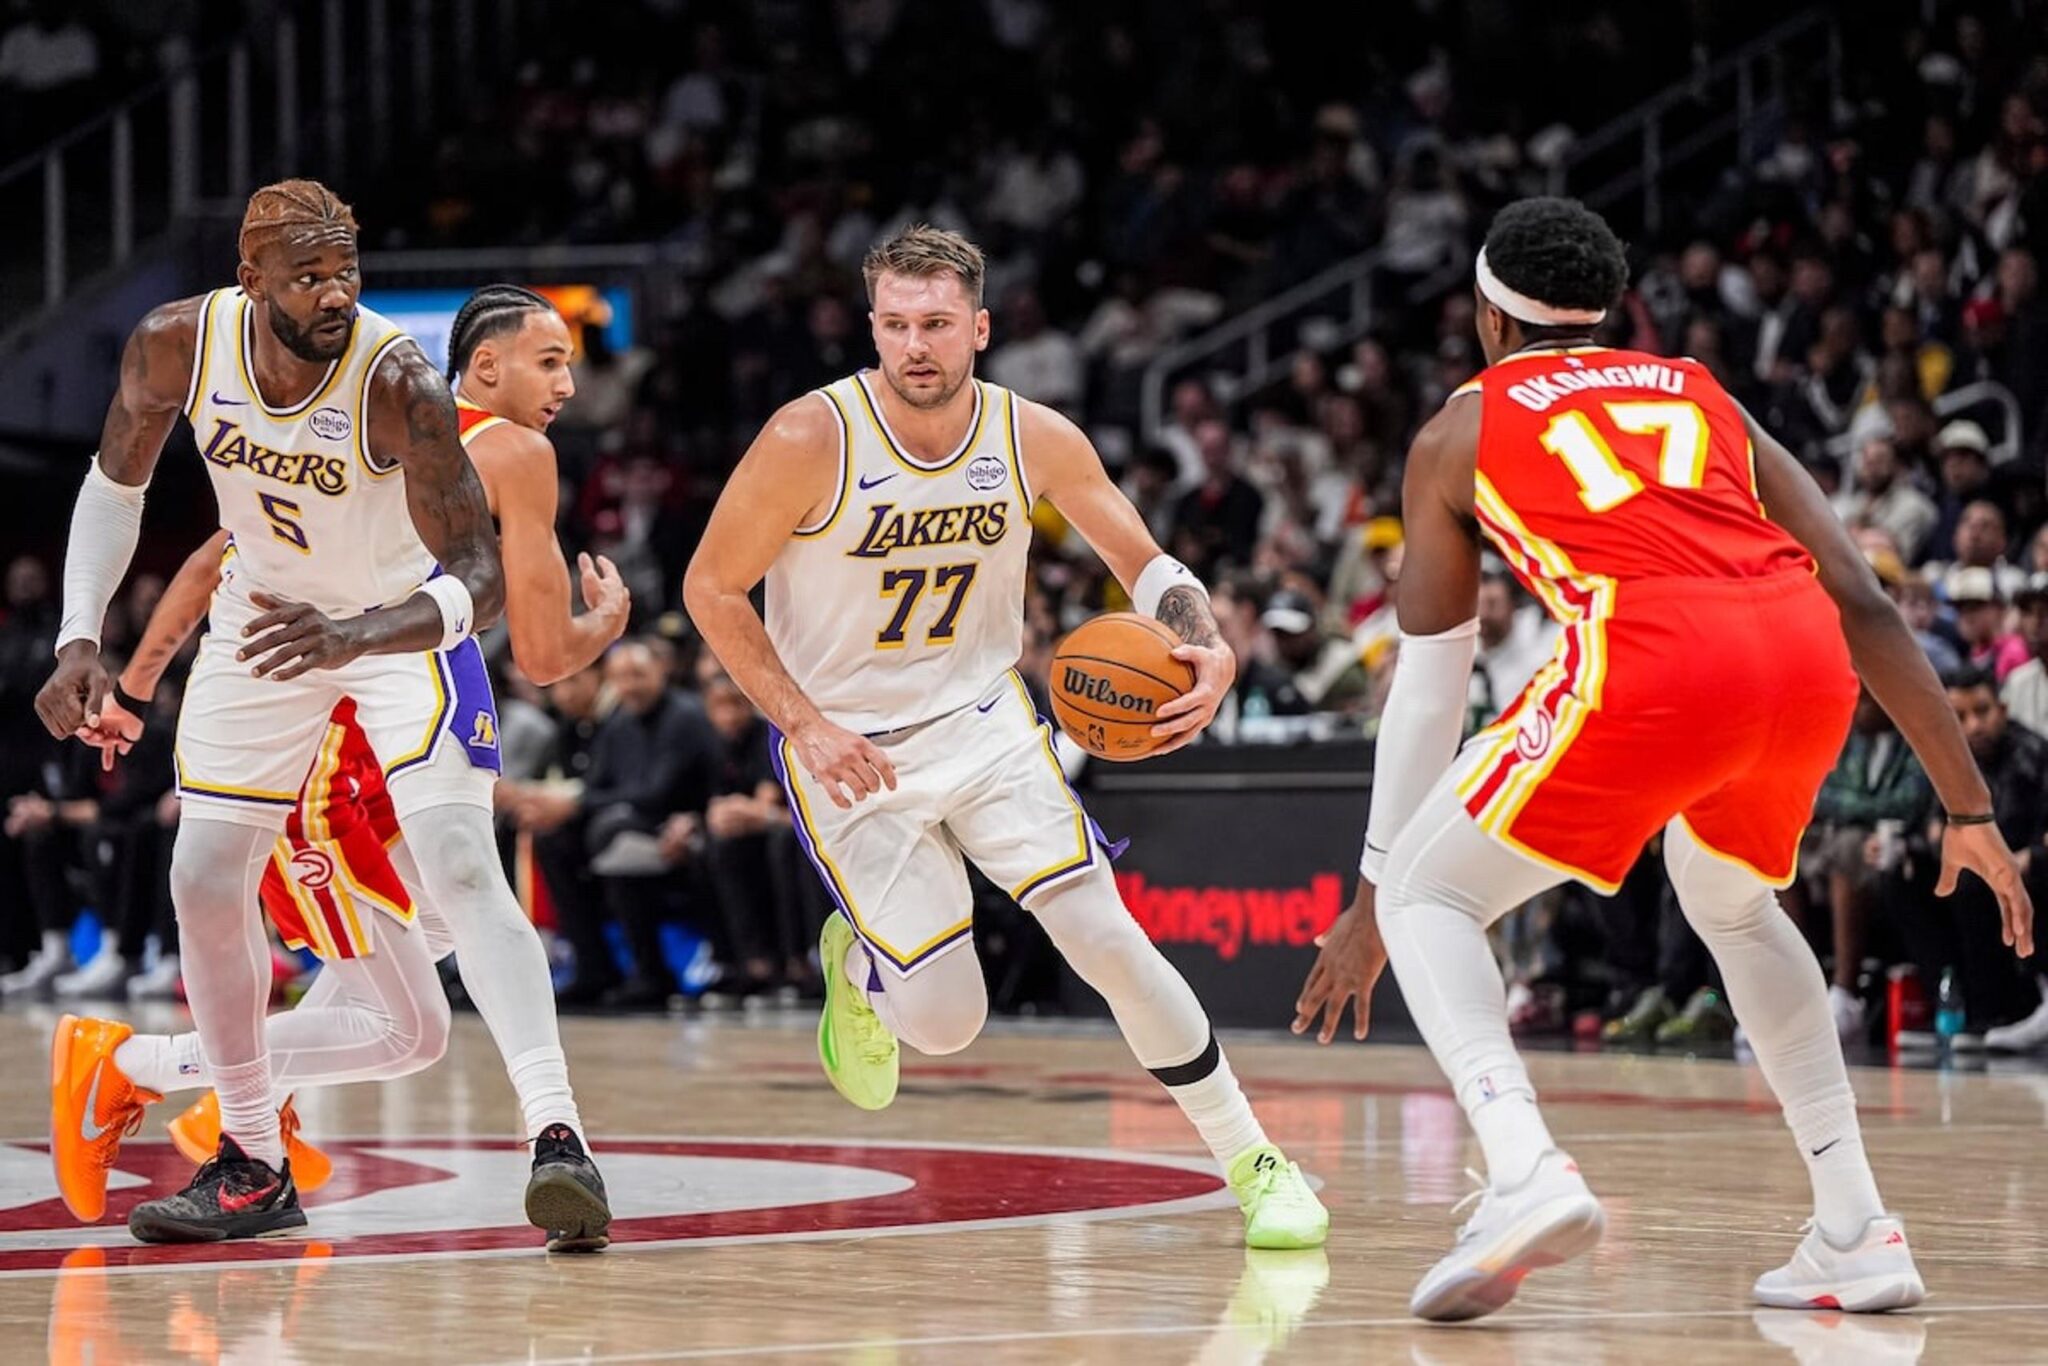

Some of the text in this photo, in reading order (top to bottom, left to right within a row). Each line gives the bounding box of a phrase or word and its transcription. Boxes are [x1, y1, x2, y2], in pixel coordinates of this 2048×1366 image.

[1507, 364, 1685, 412] OKONGWU
[313, 415, 350, 432] bibigo
[203, 417, 349, 497] LAKERS
[968, 464, 1005, 481] bibigo
[1539, 400, 1711, 513] 17
[257, 491, 311, 555] 5
[845, 500, 1010, 558] LAKERS
[875, 558, 980, 650] 77
[1063, 666, 1153, 714] Wilson
